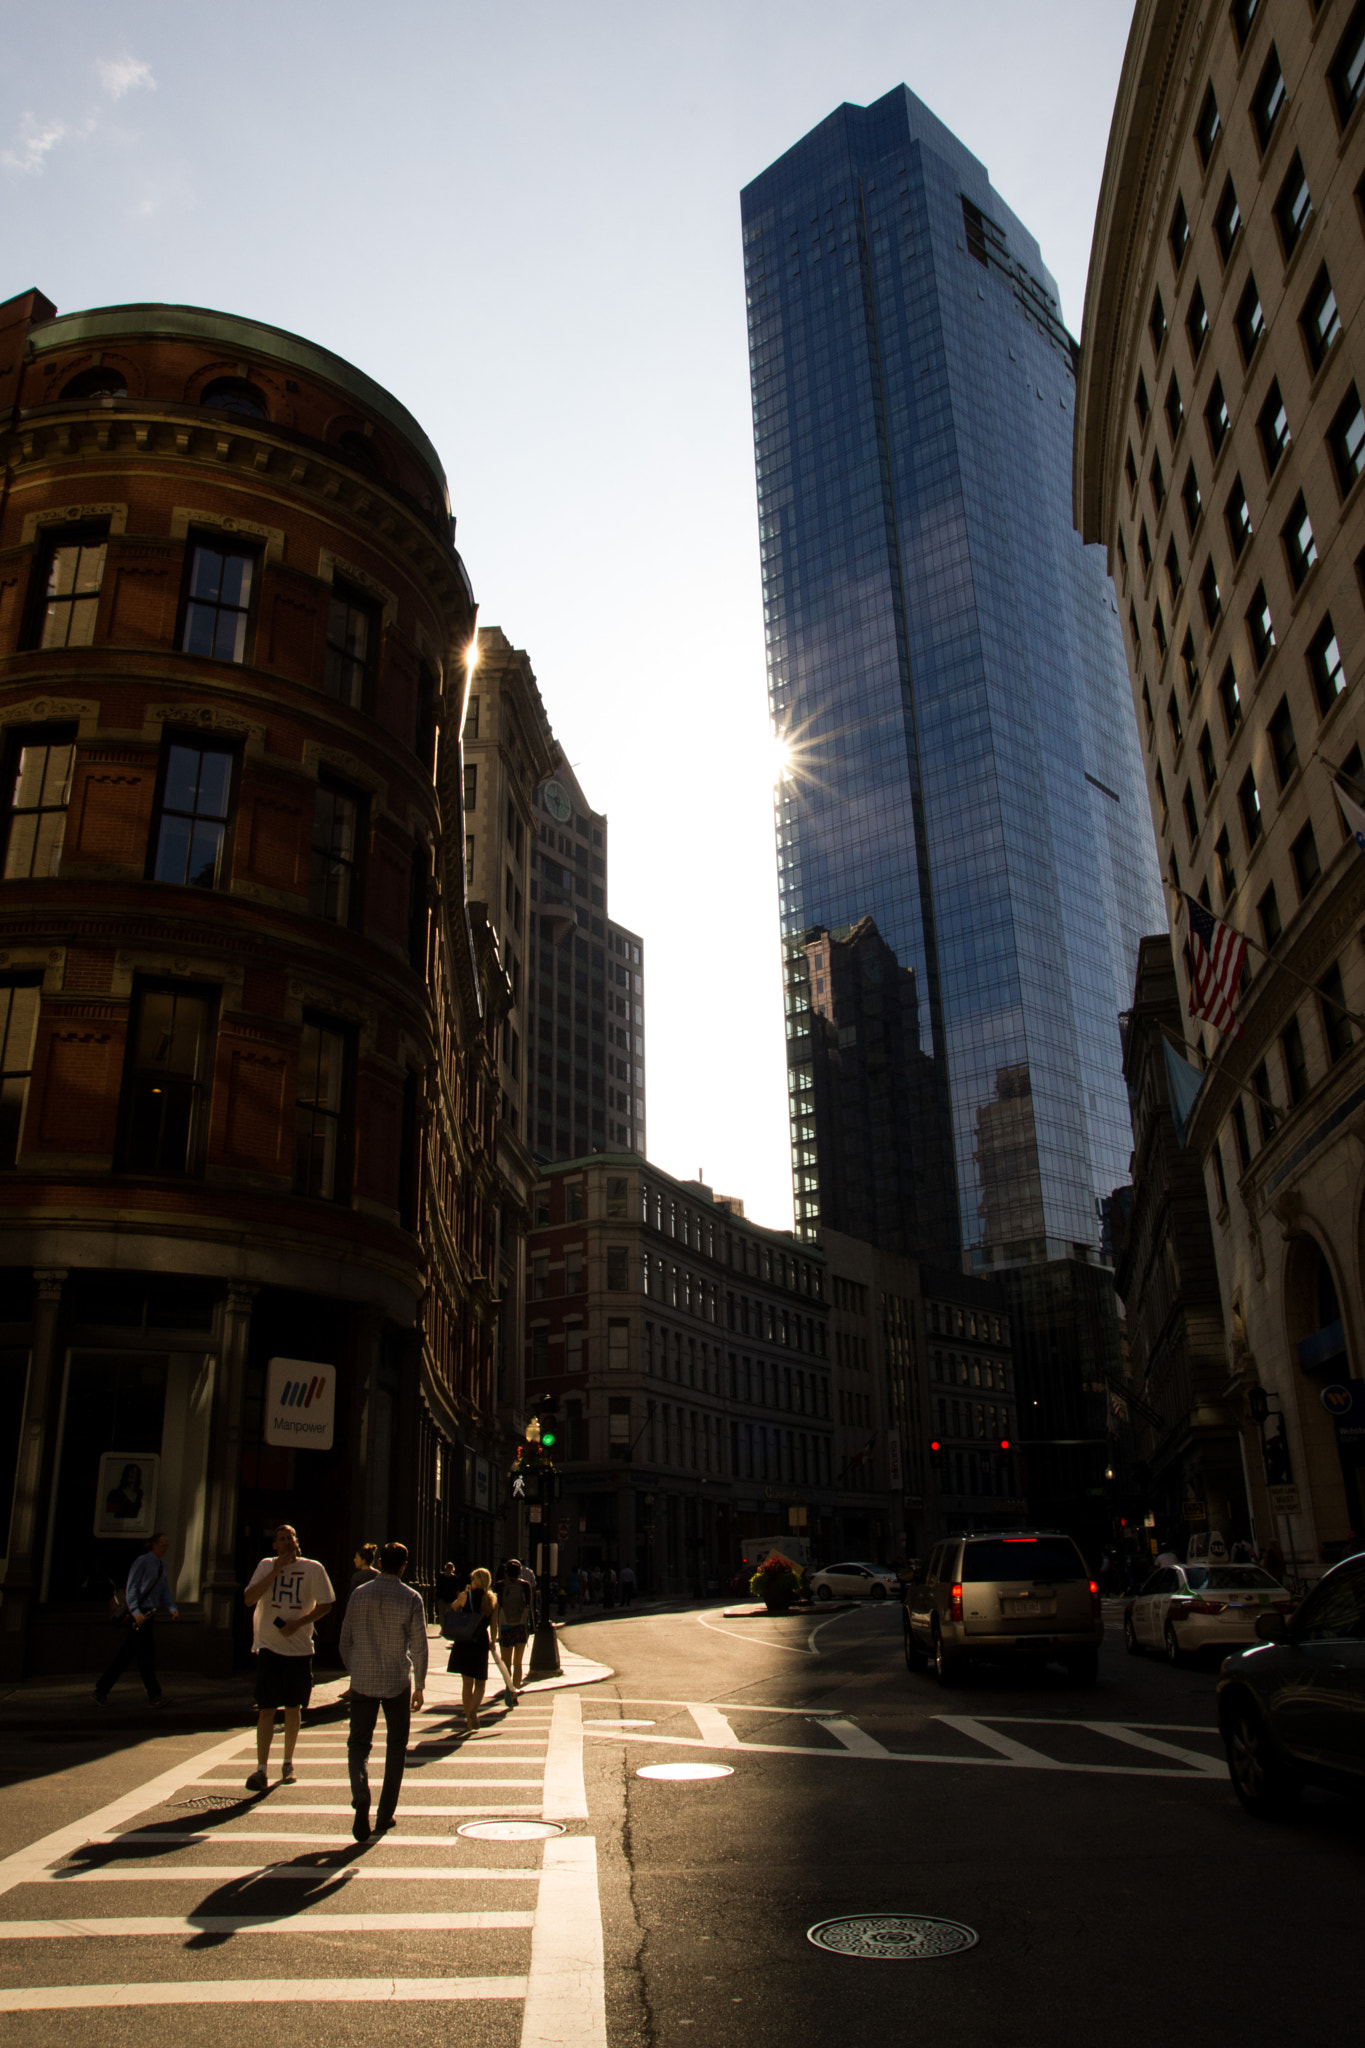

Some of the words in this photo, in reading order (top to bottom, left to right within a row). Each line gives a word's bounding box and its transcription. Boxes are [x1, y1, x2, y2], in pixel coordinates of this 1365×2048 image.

[274, 1417, 327, 1434] Manpower
[1275, 1495, 1294, 1503] MUST
[1212, 1544, 1225, 1553] TAXI
